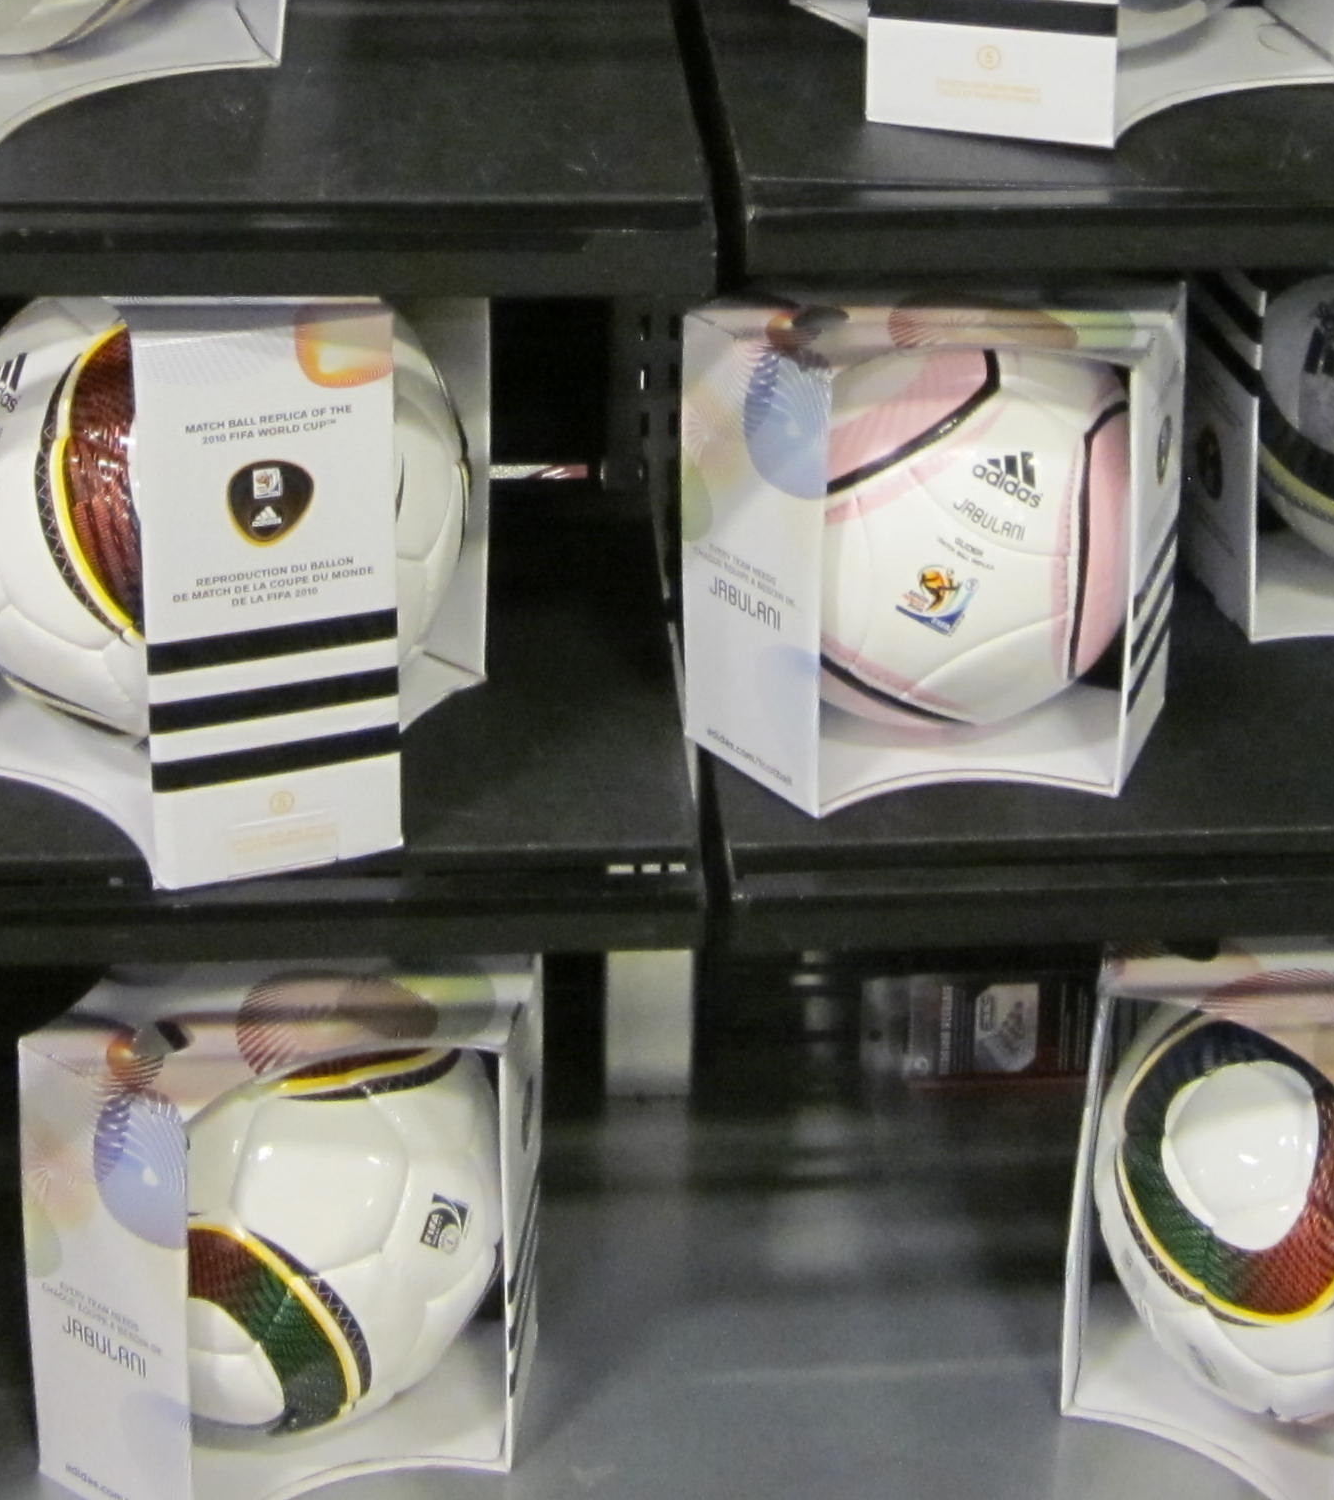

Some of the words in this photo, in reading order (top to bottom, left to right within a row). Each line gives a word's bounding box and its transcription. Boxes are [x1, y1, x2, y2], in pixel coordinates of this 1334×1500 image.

[184, 419, 225, 434] MATCH
[227, 416, 255, 429] BALL
[258, 409, 308, 425] REPLICA
[310, 406, 327, 418] OF
[329, 403, 352, 415] THE
[228, 428, 255, 441] FIFA
[257, 422, 300, 438] WORLD
[971, 463, 1043, 509] adidas
[952, 497, 1027, 541] JABULANI
[195, 565, 288, 587] REPRODUCTION
[289, 562, 307, 574] DU
[309, 555, 354, 571] BALLON
[708, 575, 782, 632] JABULANI
[60, 1315, 148, 1379] JABULANI
